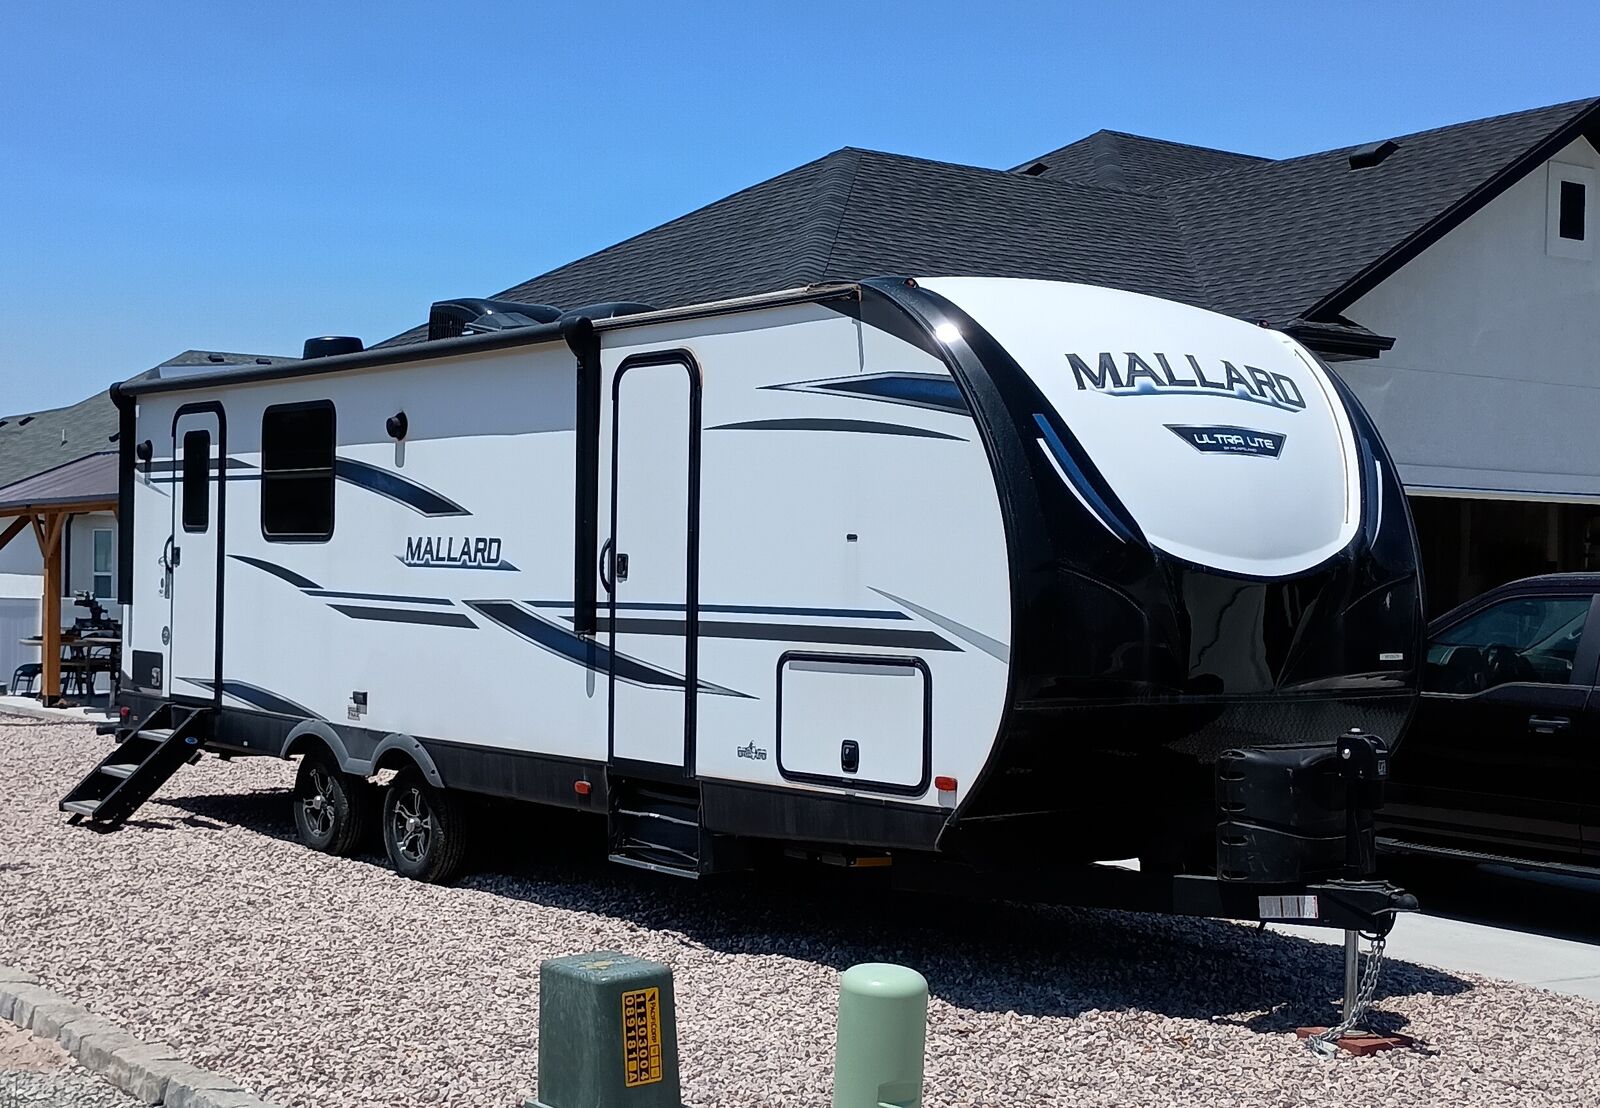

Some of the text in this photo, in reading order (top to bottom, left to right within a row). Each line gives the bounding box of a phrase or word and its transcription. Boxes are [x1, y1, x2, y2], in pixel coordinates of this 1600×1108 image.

[1064, 351, 1307, 409] MALLARD
[1193, 433, 1275, 450] ULTRA LITE
[405, 536, 502, 564] MALLARD
